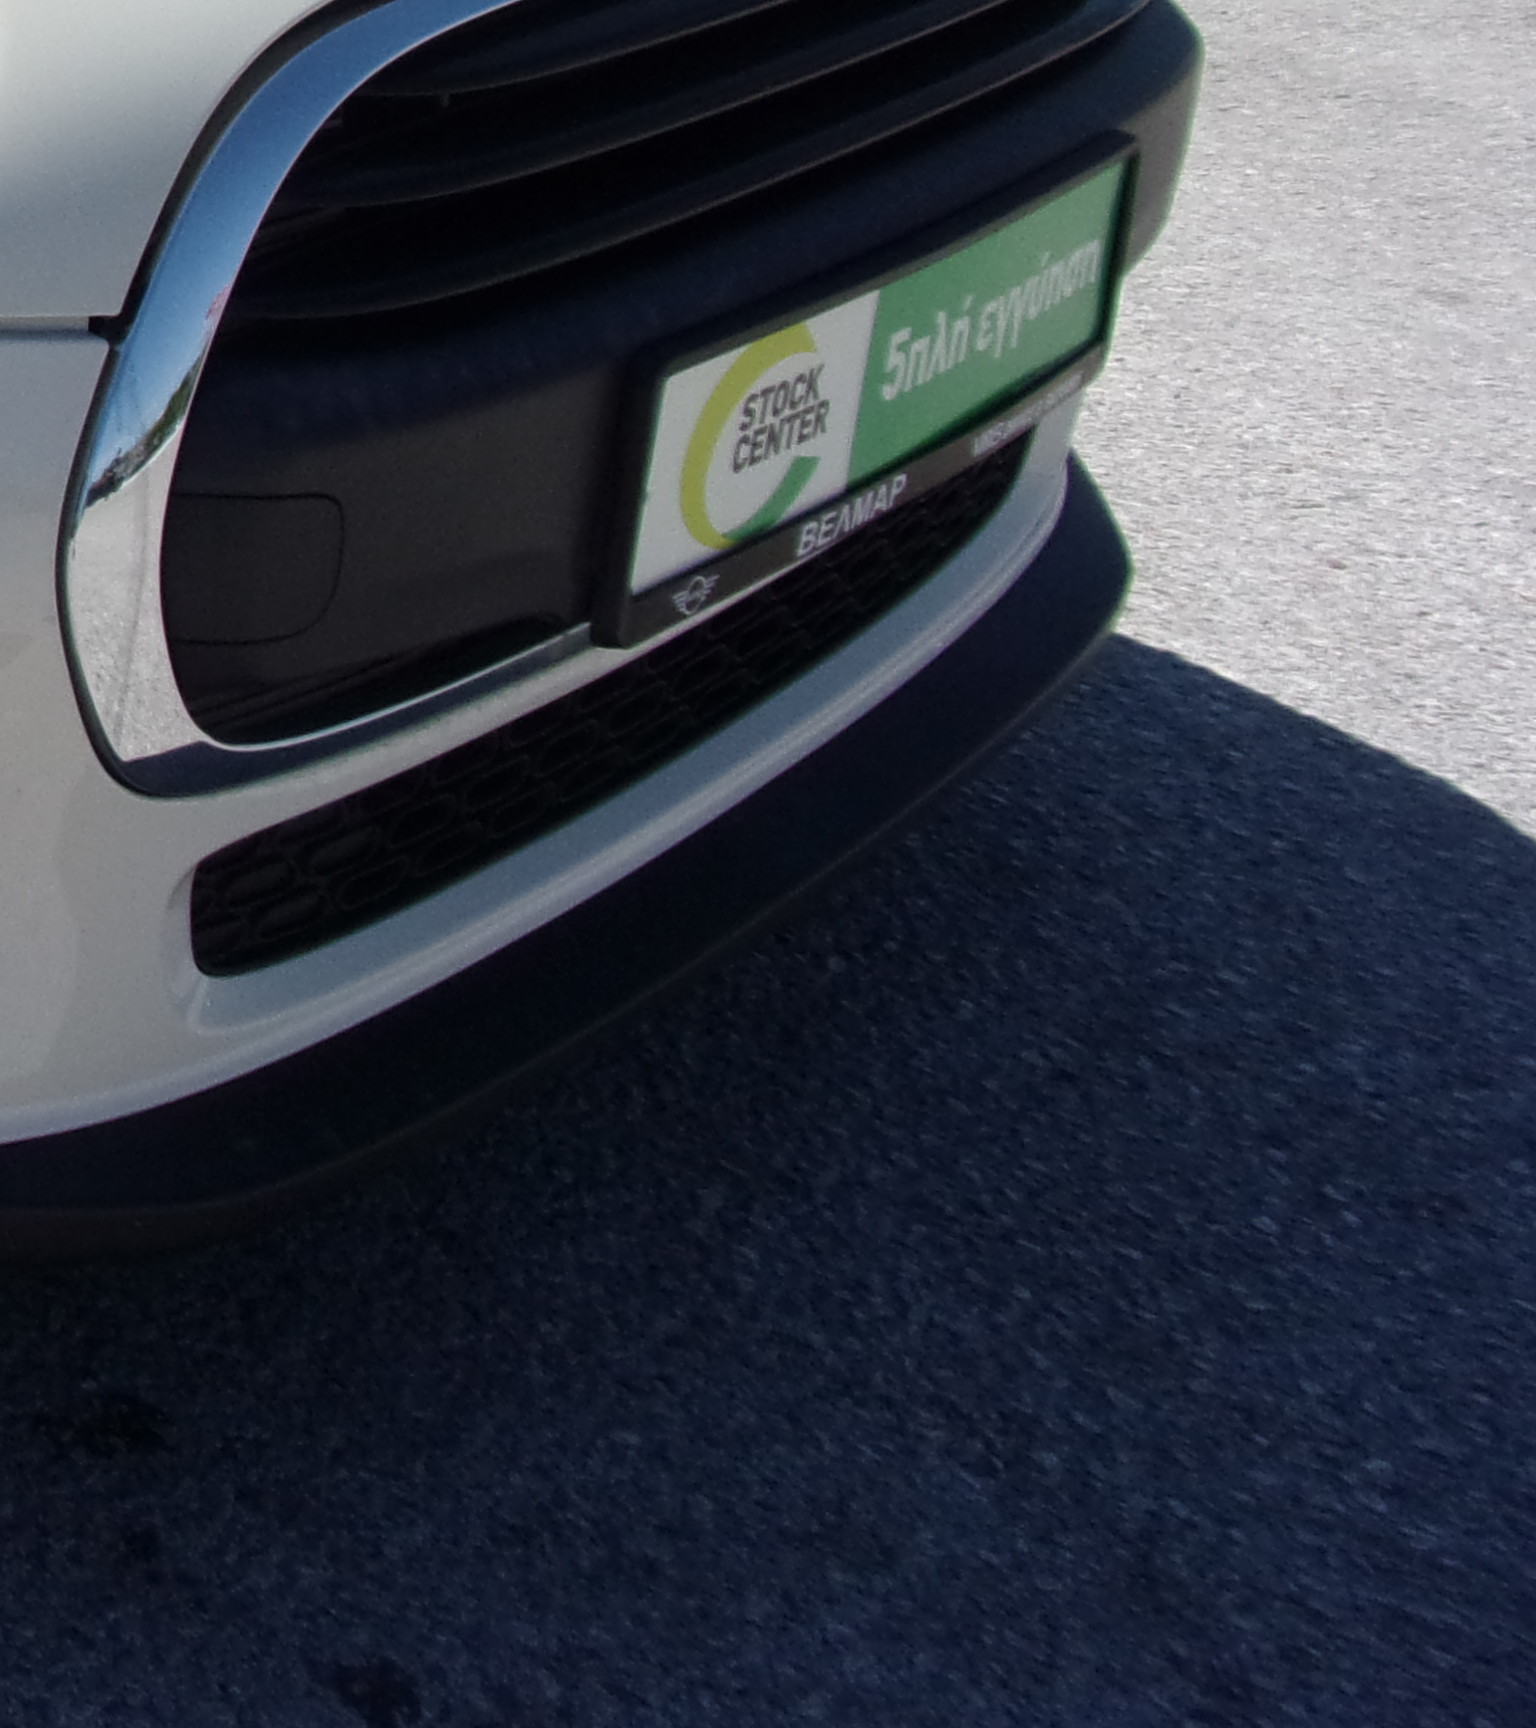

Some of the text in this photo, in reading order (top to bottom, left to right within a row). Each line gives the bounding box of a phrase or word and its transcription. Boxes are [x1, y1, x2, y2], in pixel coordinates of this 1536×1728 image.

[881, 294, 974, 401] 5πλή
[738, 363, 826, 432] STOCK
[732, 398, 830, 474] CENTER
